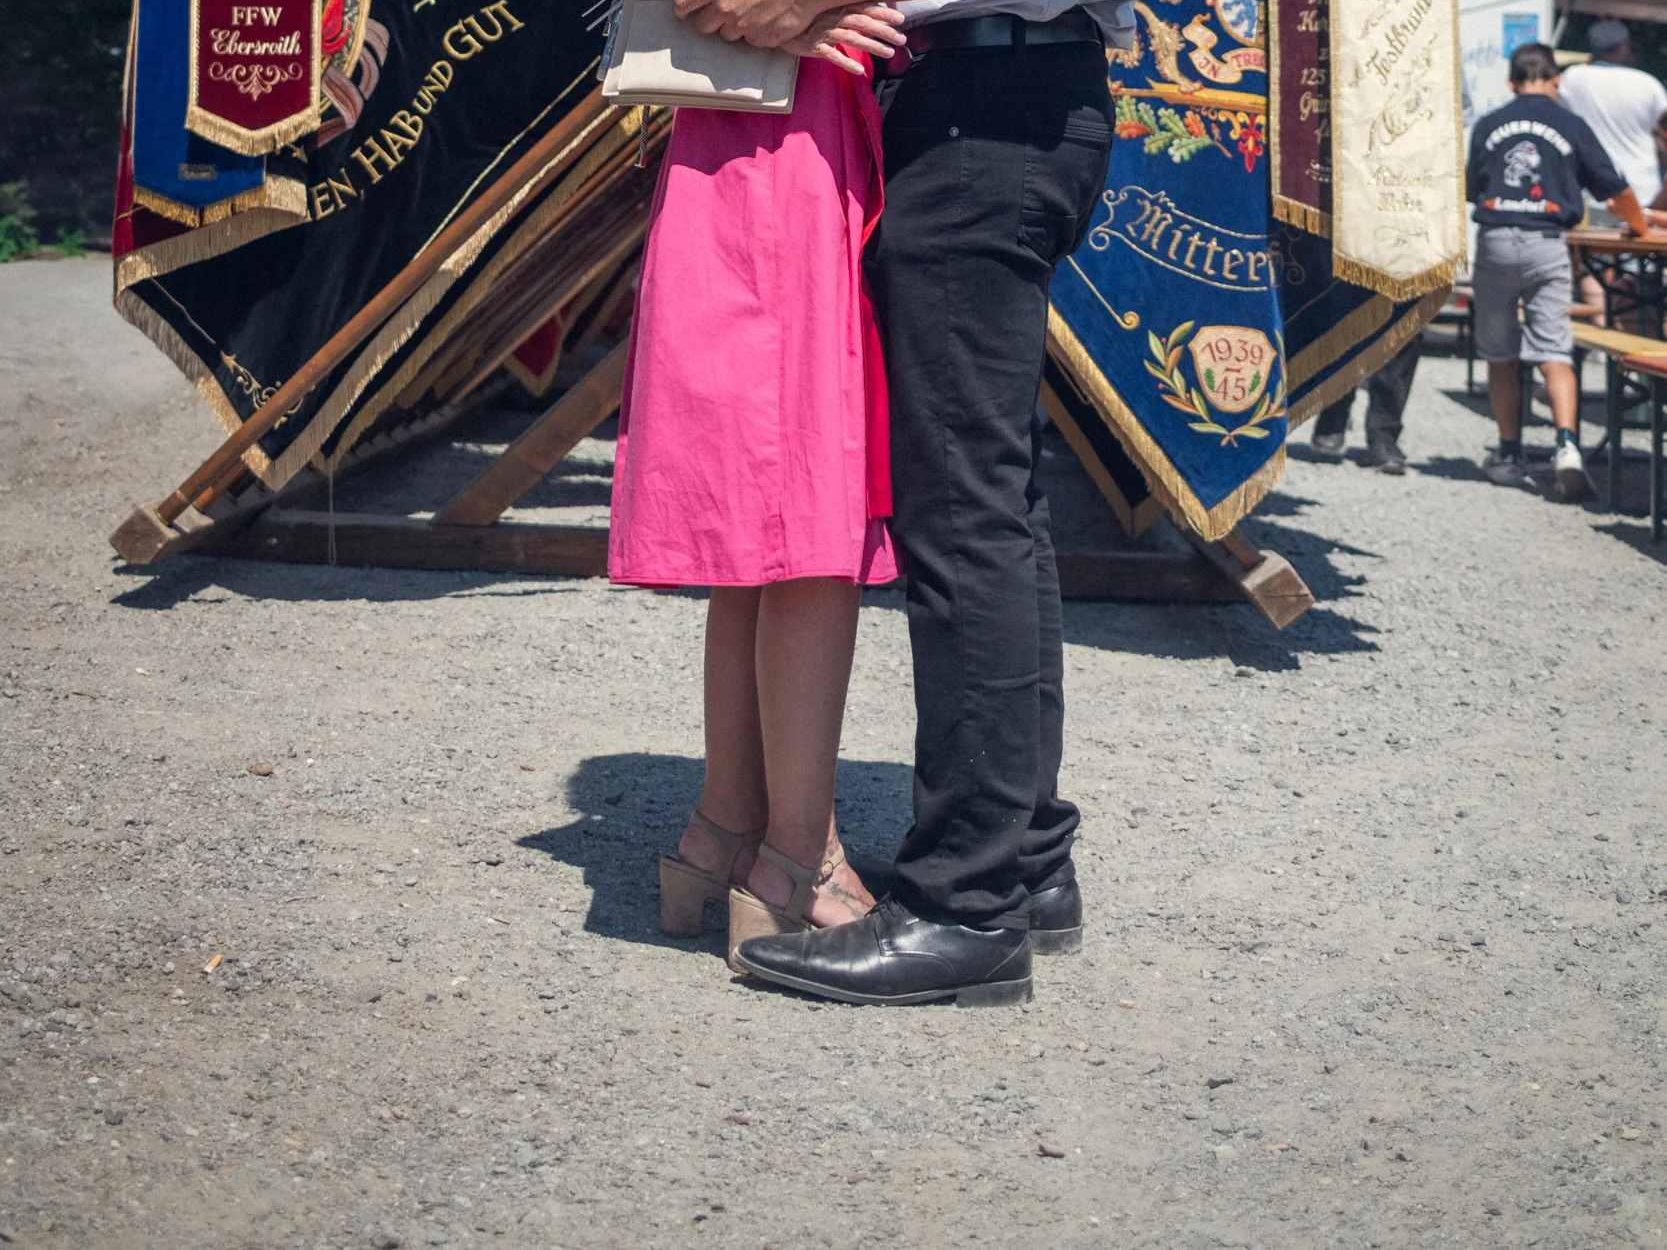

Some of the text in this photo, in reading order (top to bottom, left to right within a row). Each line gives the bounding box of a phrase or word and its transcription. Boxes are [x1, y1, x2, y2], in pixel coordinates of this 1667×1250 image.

[231, 5, 283, 28] FFW
[305, 0, 525, 222] EN, HAB UND GUT
[1201, 337, 1264, 366] 1939
[1213, 376, 1248, 401] 45
